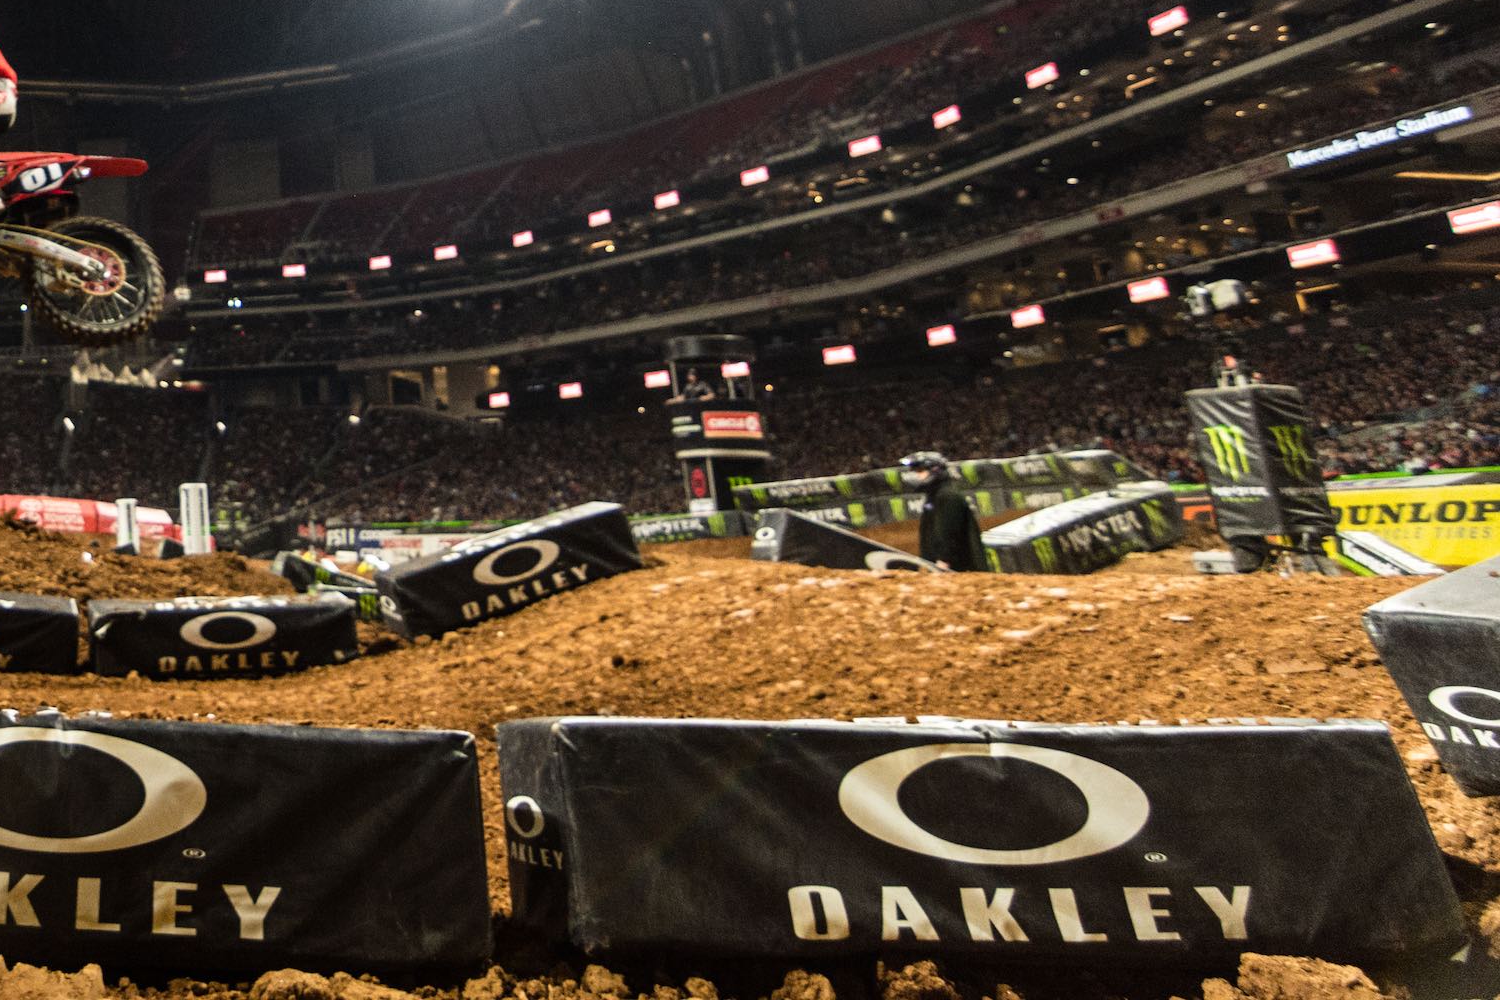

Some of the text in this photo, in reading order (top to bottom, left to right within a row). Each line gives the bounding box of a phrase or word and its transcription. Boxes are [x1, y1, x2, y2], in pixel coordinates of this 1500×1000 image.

[1396, 106, 1473, 137] Stadium
[461, 562, 589, 621] OAKLEY
[156, 649, 300, 673] OAKLEY
[787, 885, 1252, 943] OAKLEY
